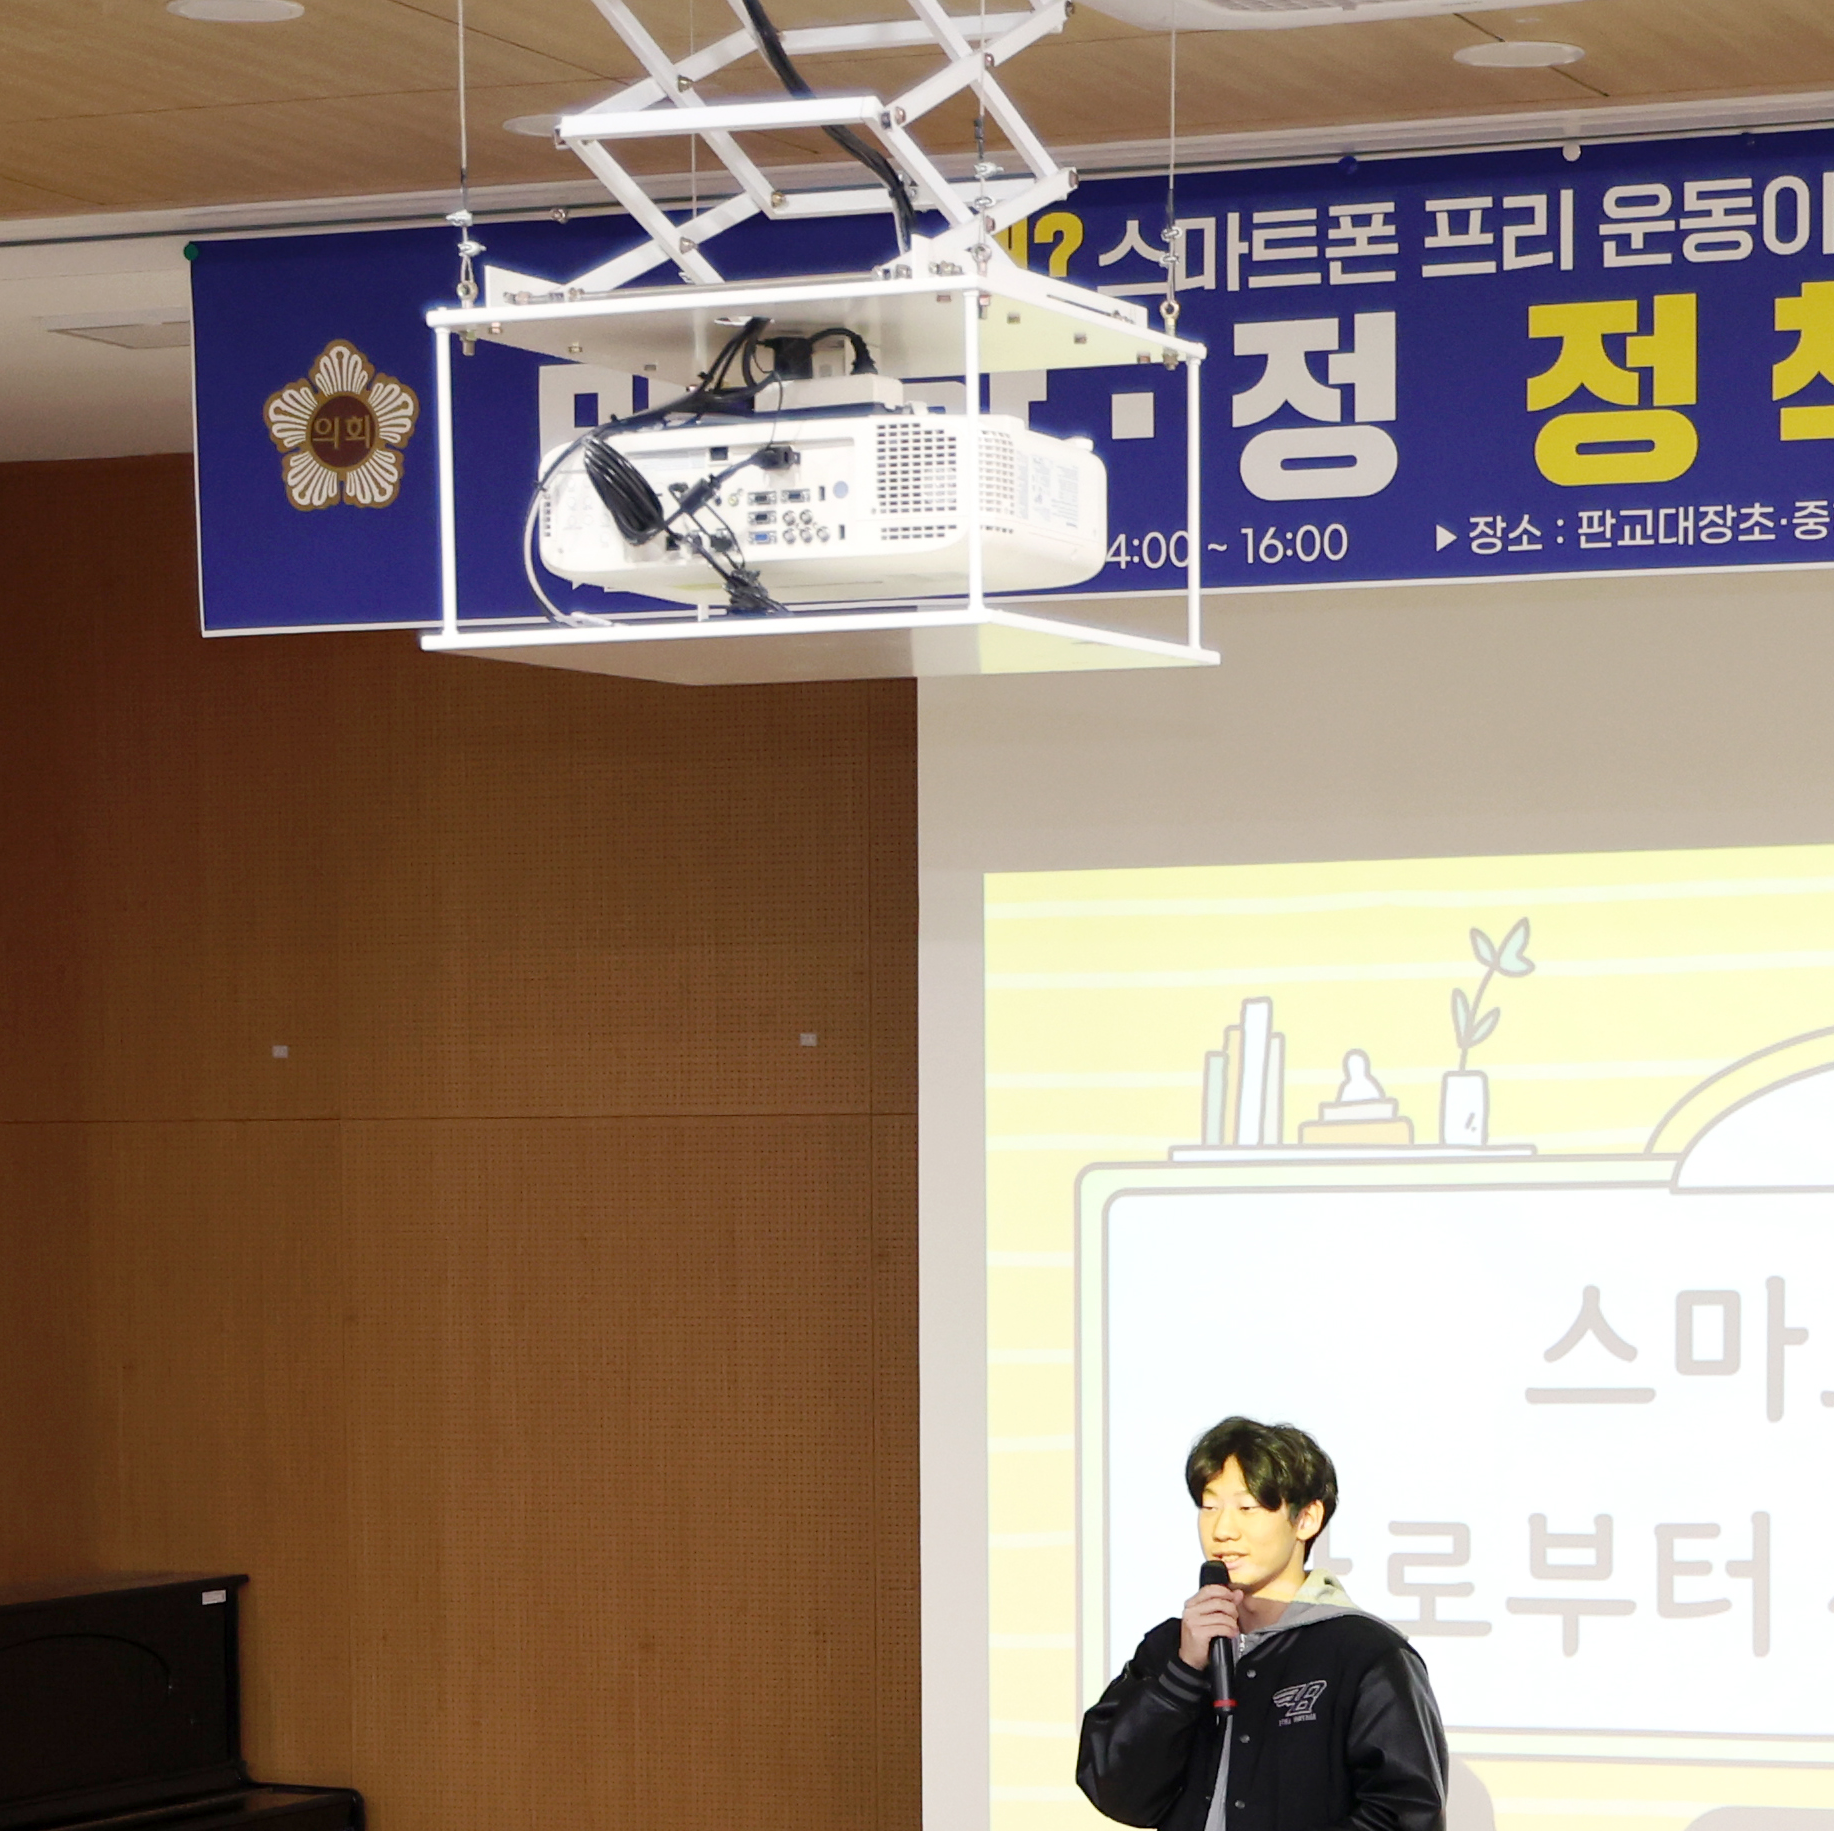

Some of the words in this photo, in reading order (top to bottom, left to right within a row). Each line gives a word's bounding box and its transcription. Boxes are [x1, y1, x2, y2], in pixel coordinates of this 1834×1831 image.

[1097, 200, 1399, 297] 스마트폰
[1422, 190, 1573, 277] 프리
[311, 415, 372, 450] 의회
[1107, 531, 1189, 569] 4:00
[1241, 524, 1347, 564] 16:00
[1470, 514, 1543, 555] 장소
